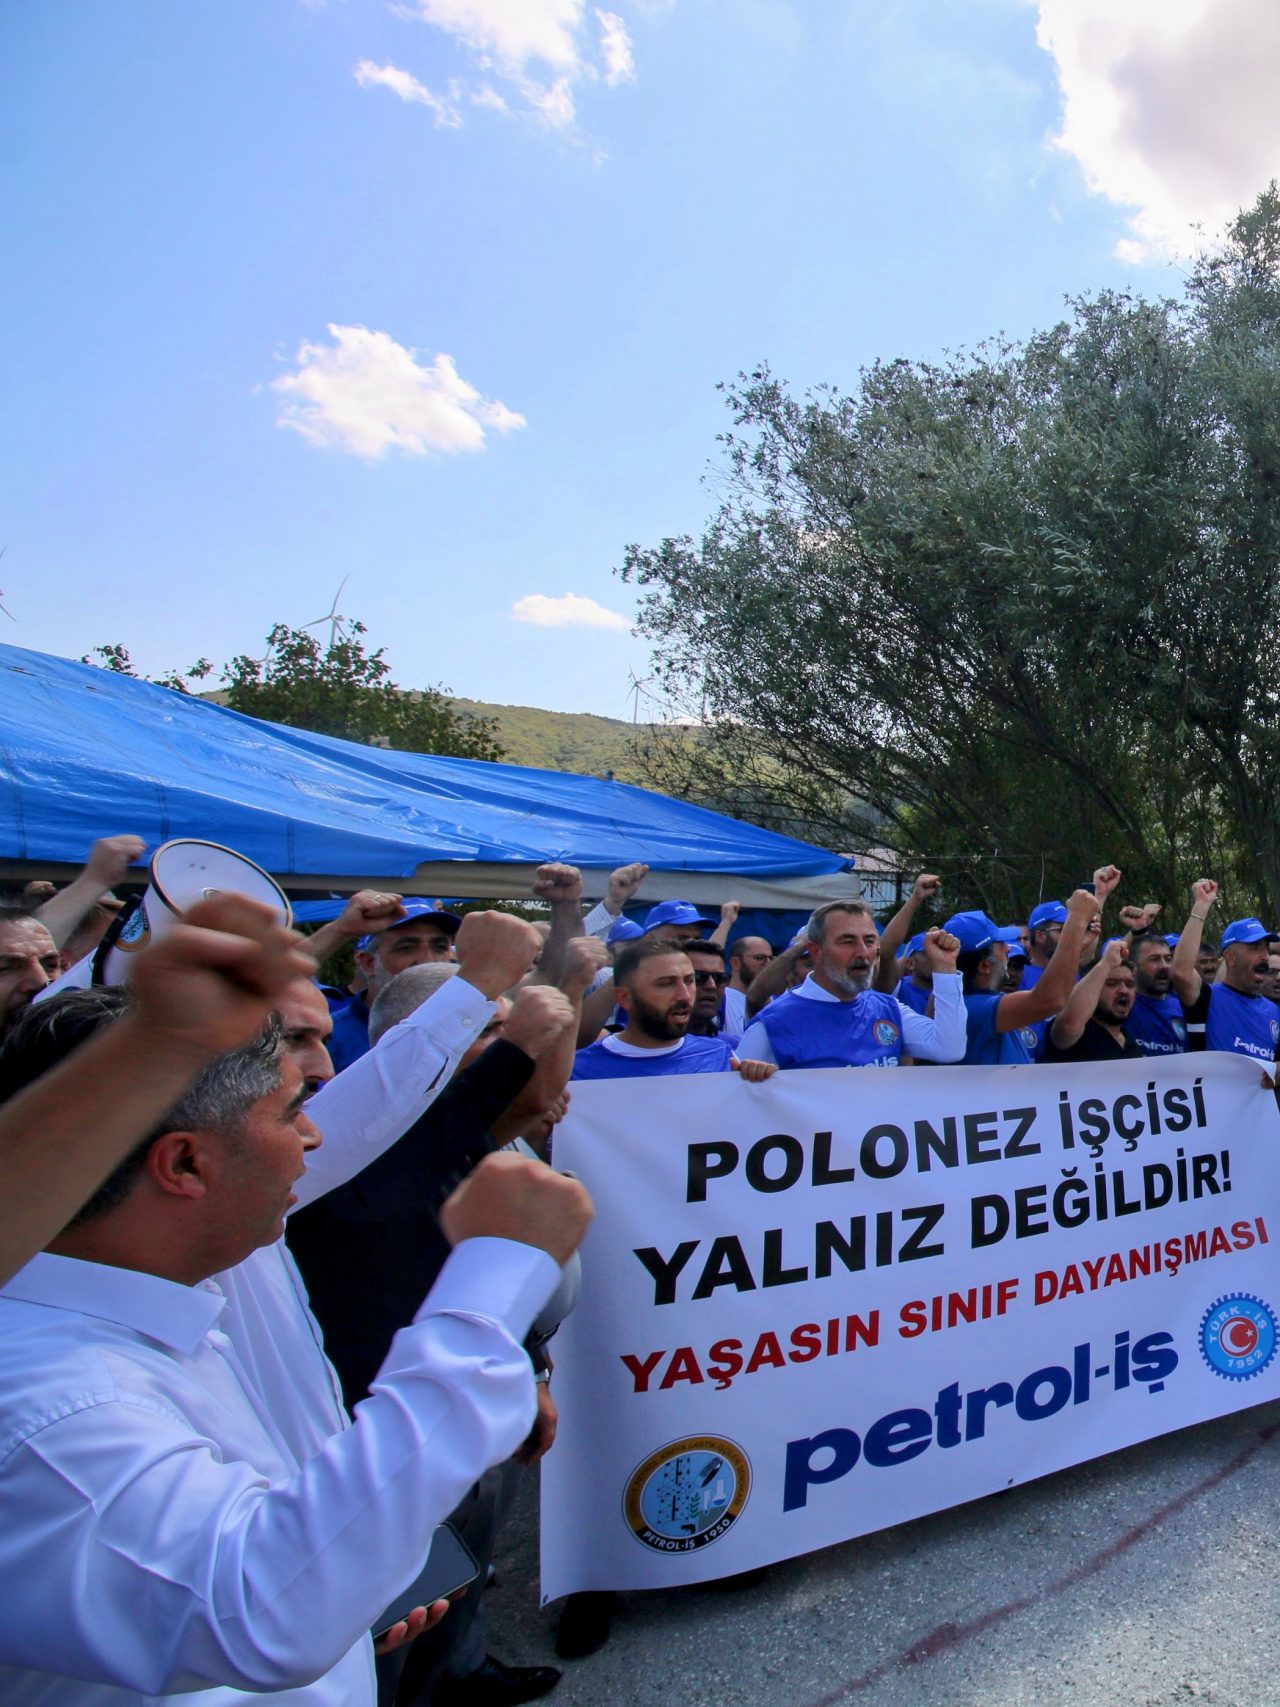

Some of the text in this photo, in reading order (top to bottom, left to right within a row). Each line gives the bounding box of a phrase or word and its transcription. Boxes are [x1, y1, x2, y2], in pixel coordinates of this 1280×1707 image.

[687, 1077, 1208, 1203] POLONEZ İŞÇİSİ
[633, 1146, 1232, 1306] YALNIZ DEĞİLDİR!
[620, 1217, 1270, 1393] YAŞASIN SINIF DAYANIŞMASI
[1227, 1349, 1263, 1369] 1952
[782, 1329, 1179, 1513] petrol-iş
[703, 1518, 731, 1542] 1950
